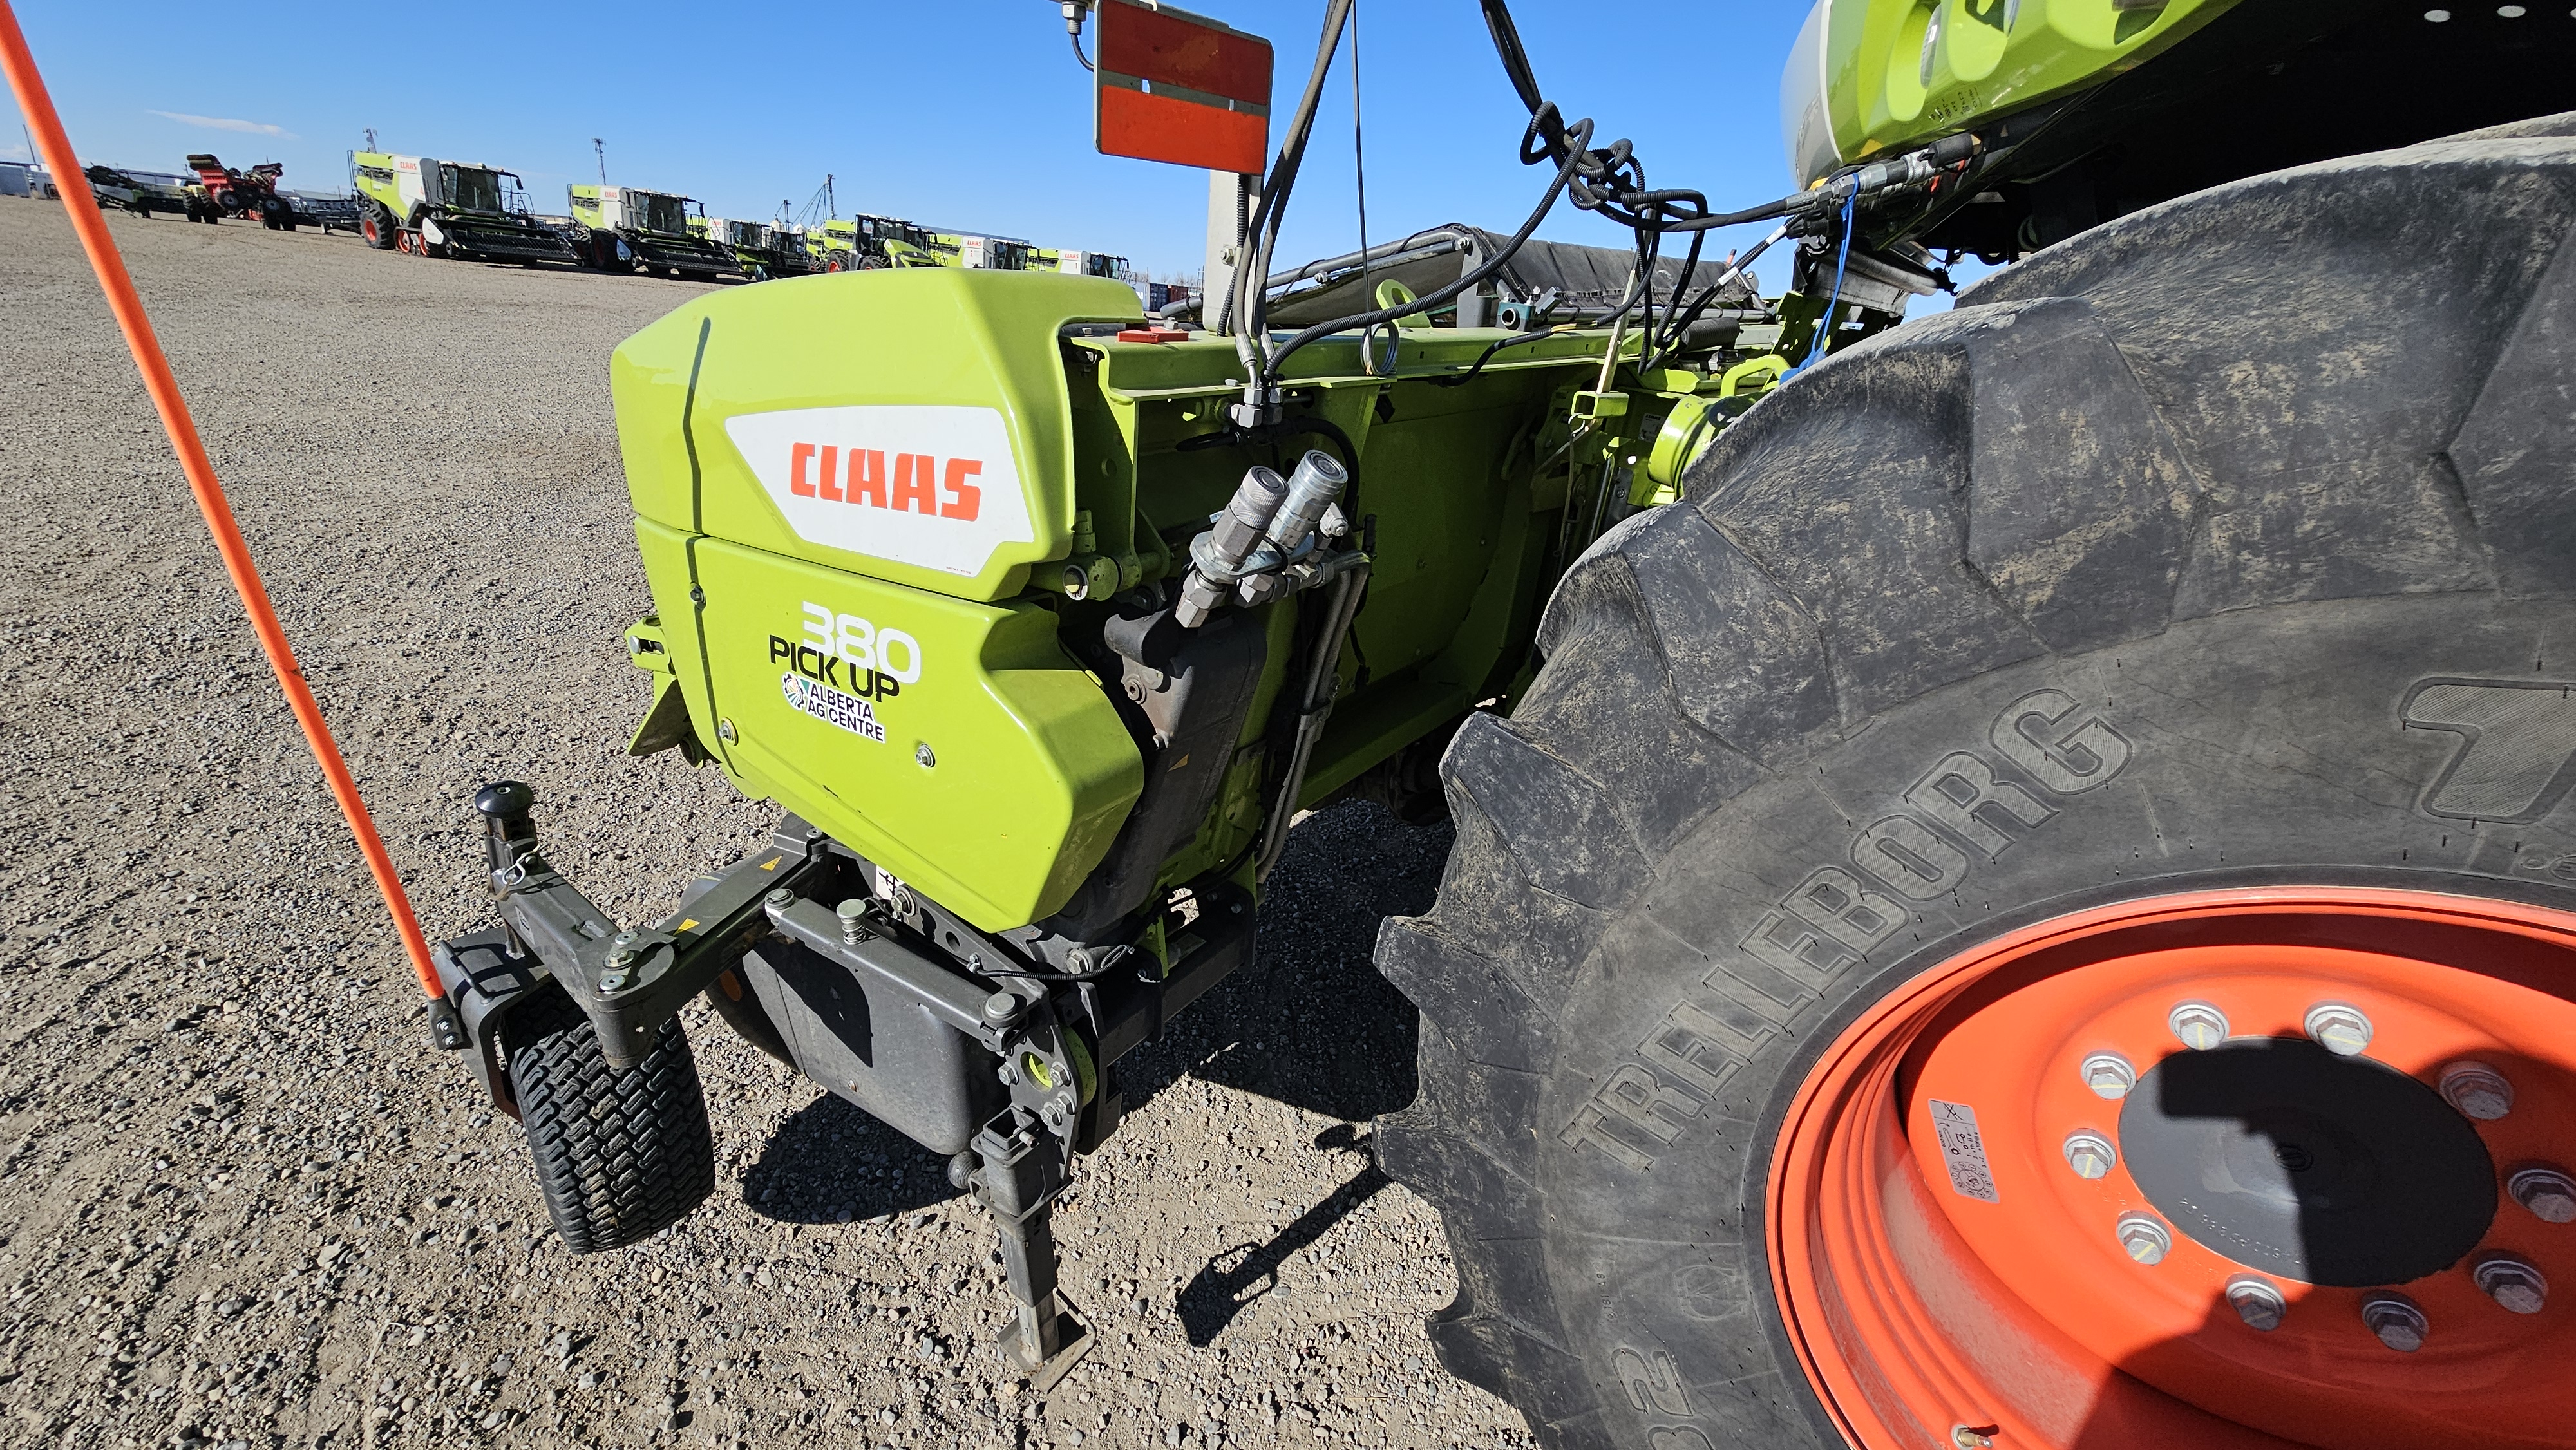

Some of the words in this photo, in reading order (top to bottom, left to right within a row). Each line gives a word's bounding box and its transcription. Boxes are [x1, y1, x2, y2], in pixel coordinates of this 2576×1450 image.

[400, 162, 417, 170] CLAAS
[791, 442, 983, 522] CLAAS
[769, 634, 840, 688] PICK
[849, 662, 900, 703] UP
[802, 600, 922, 684] 380
[808, 699, 826, 719] AG
[829, 708, 884, 742] CENTRE
[810, 683, 873, 721] ALBERTA
[1557, 688, 2133, 1174] TRELLEBORG
